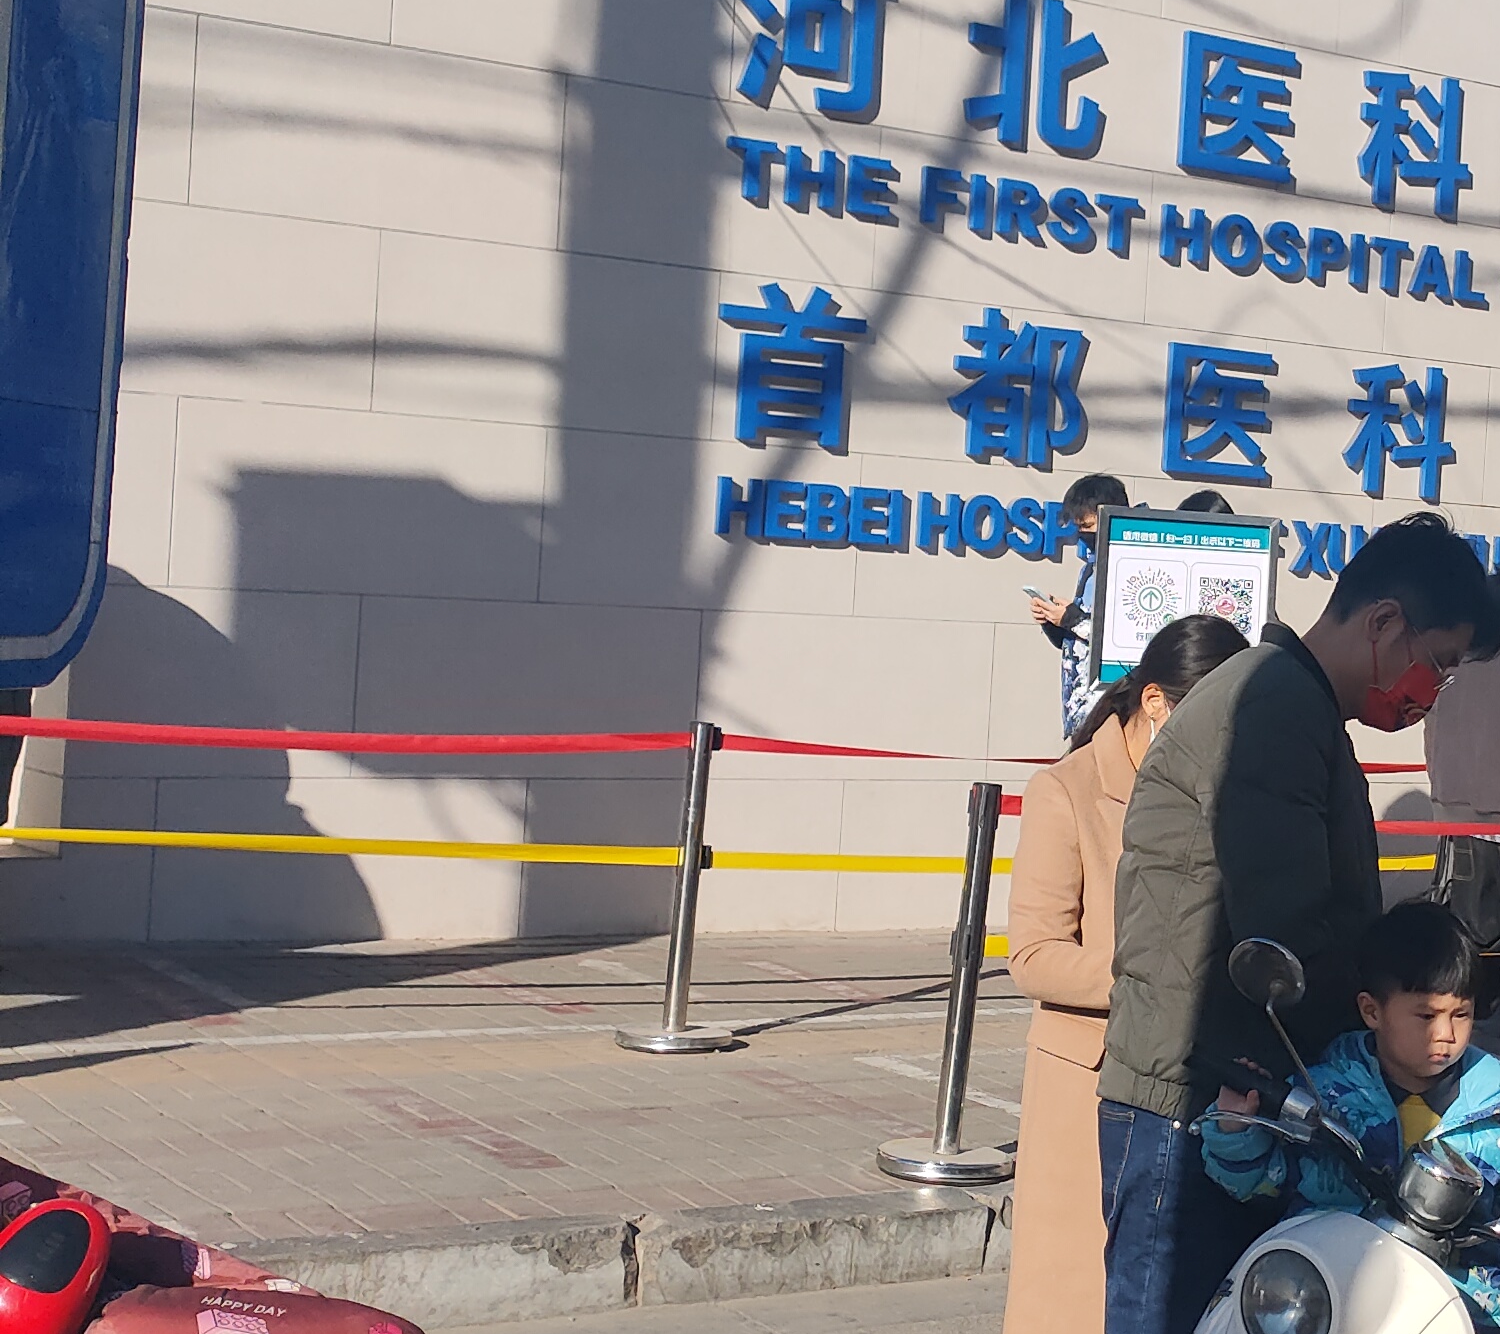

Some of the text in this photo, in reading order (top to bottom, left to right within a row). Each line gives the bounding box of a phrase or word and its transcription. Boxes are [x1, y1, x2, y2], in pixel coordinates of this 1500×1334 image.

[726, 135, 901, 227] THE
[920, 166, 1145, 259] FIRST
[1159, 204, 1489, 310] HOSPITAL
[714, 475, 909, 551] HEBEI
[201, 1295, 287, 1318] HAPPY DAY
